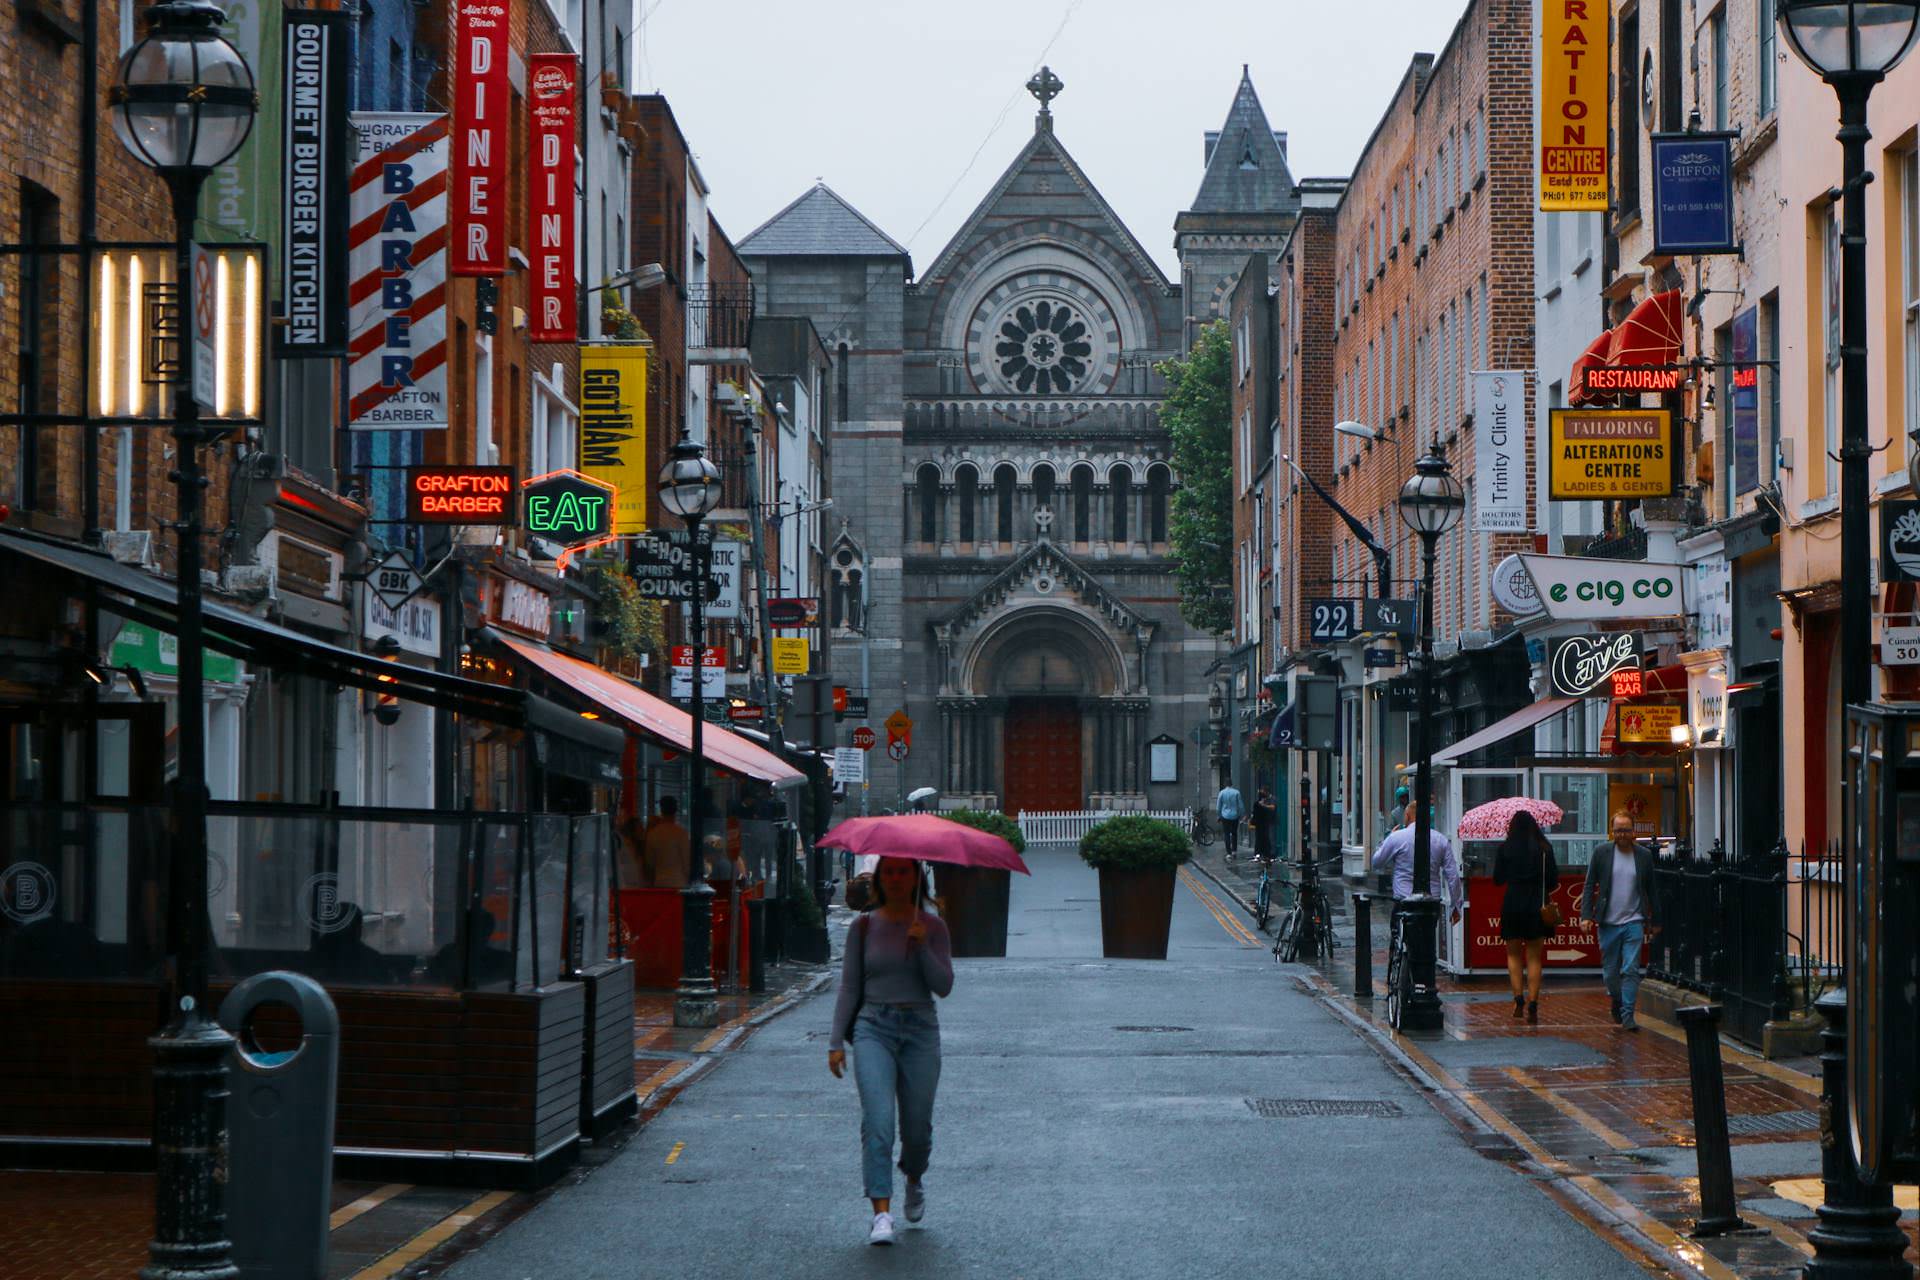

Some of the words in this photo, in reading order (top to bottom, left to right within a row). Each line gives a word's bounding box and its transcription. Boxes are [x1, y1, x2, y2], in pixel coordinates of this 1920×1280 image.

[469, 17, 496, 27] Finer
[295, 24, 320, 136] GOURMET
[372, 124, 442, 136] GRAFT
[374, 141, 434, 153] BAER
[468, 37, 492, 261] DINER
[1547, 150, 1601, 172] CENTRE
[1663, 165, 1721, 178] CHIFFON
[293, 143, 318, 234] BURGER
[1549, 177, 1572, 186] Estd
[1575, 177, 1599, 186] 1975
[541, 134, 562, 329] DINER
[380, 163, 417, 386] BARBER
[292, 243, 317, 344] KITCHEN
[1589, 370, 1678, 388] RESTAURANT
[370, 391, 440, 403] RAFTON
[373, 409, 434, 421] BARBER
[583, 369, 639, 466] GOTHAM
[1491, 403, 1507, 446] Clinic
[1572, 421, 1654, 435] TAILORING
[1564, 445, 1663, 459] ALTERATIONS
[1493, 452, 1510, 504] Trinity
[1585, 464, 1641, 478] CENTRE
[416, 476, 509, 492] GRAFTON
[1564, 482, 1605, 491] LADIES
[1610, 482, 1617, 491] &
[1624, 481, 1663, 491] GENTS
[422, 497, 503, 512] BARBER
[529, 492, 604, 532] EAT
[1482, 519, 1520, 527] SURGERY
[635, 565, 673, 576] SPIRITS
[379, 571, 410, 590] GBK
[1550, 583, 1568, 602] e
[1576, 580, 1625, 606] cig
[1633, 577, 1673, 598] co
[1314, 606, 1347, 637] 22
[1593, 637, 1608, 646] LA
[683, 648, 714, 656] SP
[1552, 634, 1633, 695] Cave
[1612, 672, 1640, 683] WINE
[1615, 683, 1641, 695] BAR
[853, 735, 876, 744] STOP
[1280, 730, 1291, 744] 2
[1568, 935, 1594, 945] BAR
